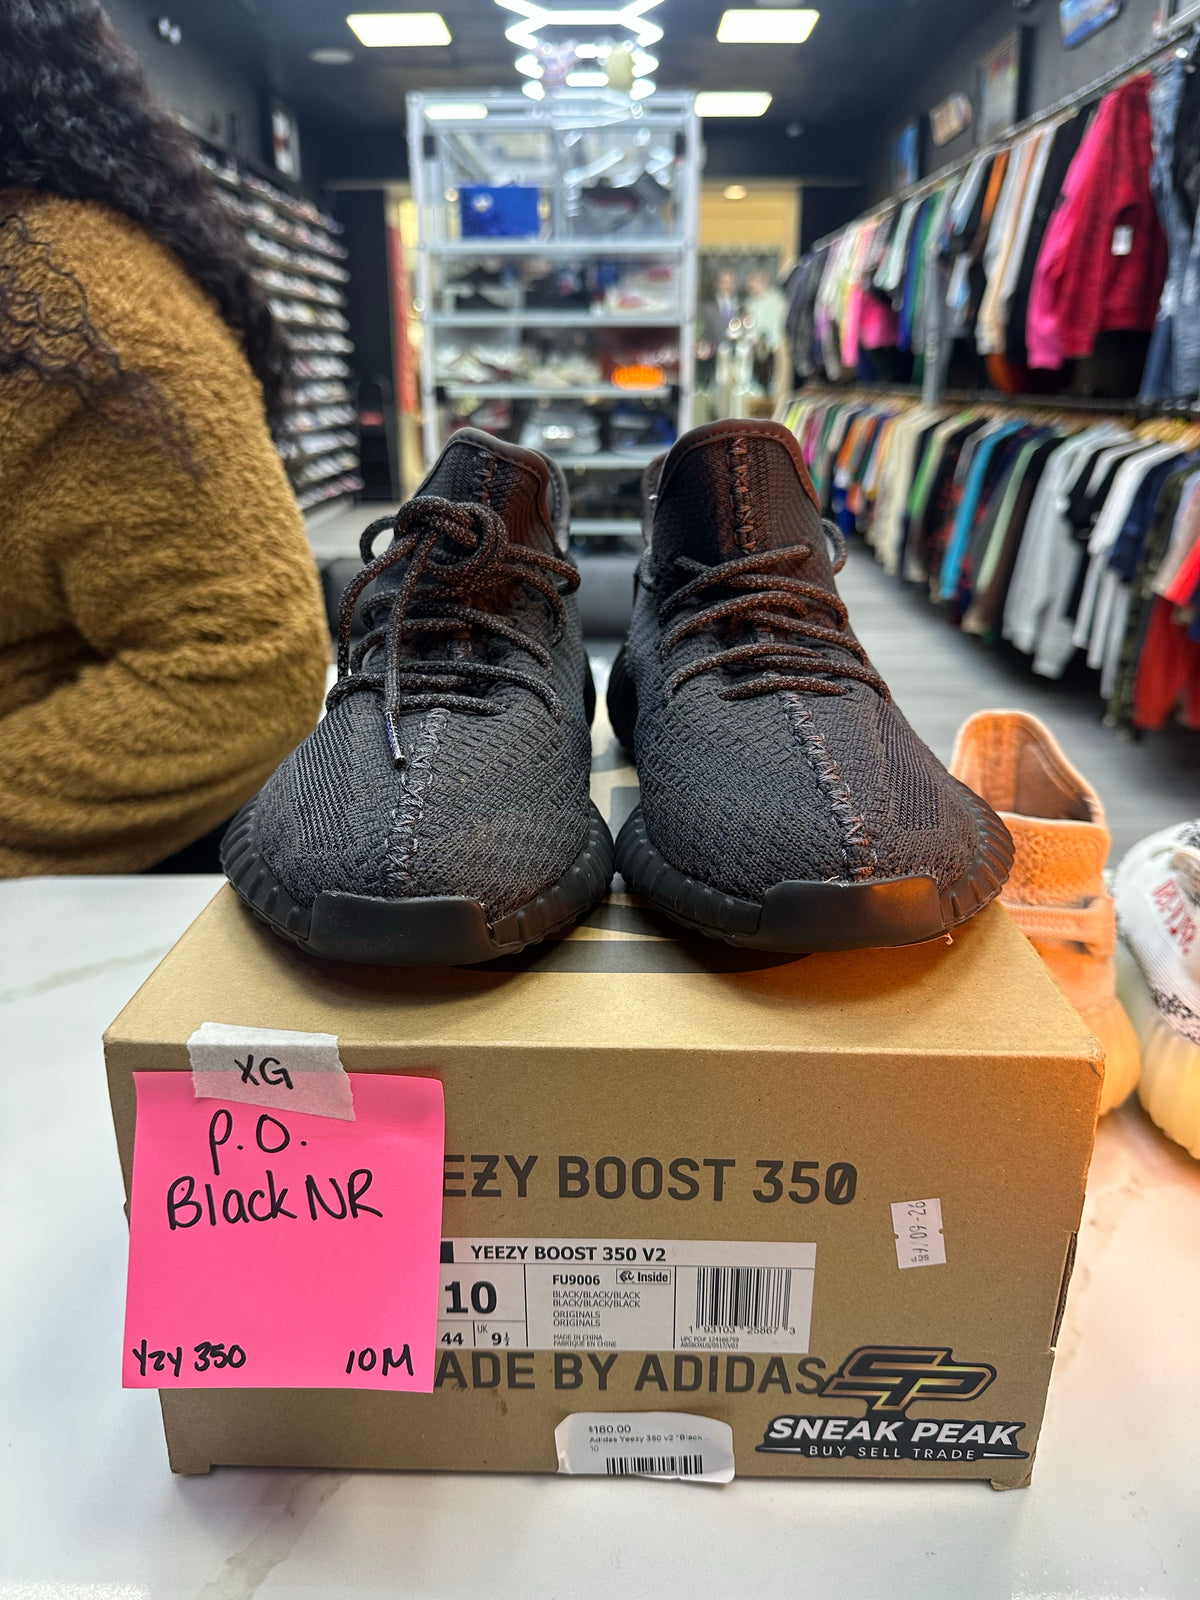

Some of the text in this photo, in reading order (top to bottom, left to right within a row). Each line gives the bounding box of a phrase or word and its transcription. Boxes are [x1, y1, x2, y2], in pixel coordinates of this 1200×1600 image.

[234, 1054, 294, 1090] XG
[443, 1154, 858, 1205] EZY BOOST 350
[166, 1168, 384, 1230] Black NR
[470, 1245, 667, 1262] YEEZY BOOST 350 V2
[552, 1274, 601, 1286] FU9006
[637, 1271, 669, 1283] Inside
[444, 1280, 498, 1315] 10
[552, 1290, 641, 1300] BLACK/BLACK/BLACK
[552, 1299, 641, 1308] BLACK/BLACK/BLACK
[552, 1310, 601, 1319] ORIGINALS
[477, 1324, 488, 1334] UK
[552, 1319, 601, 1327] ORIGINALS
[703, 1325, 736, 1334] 93103
[789, 1326, 796, 1335] 3
[441, 1332, 464, 1346] 44
[193, 1341, 248, 1372] 350
[433, 1350, 826, 1395] ADE BY ADIDAS
[587, 1424, 632, 1435] $180.00
[769, 1417, 1022, 1446] SNEAK PEAK
[619, 1435, 644, 1444] Yeezy
[590, 1445, 600, 1453] 10
[808, 1445, 976, 1460] BUY SELL TRADE
